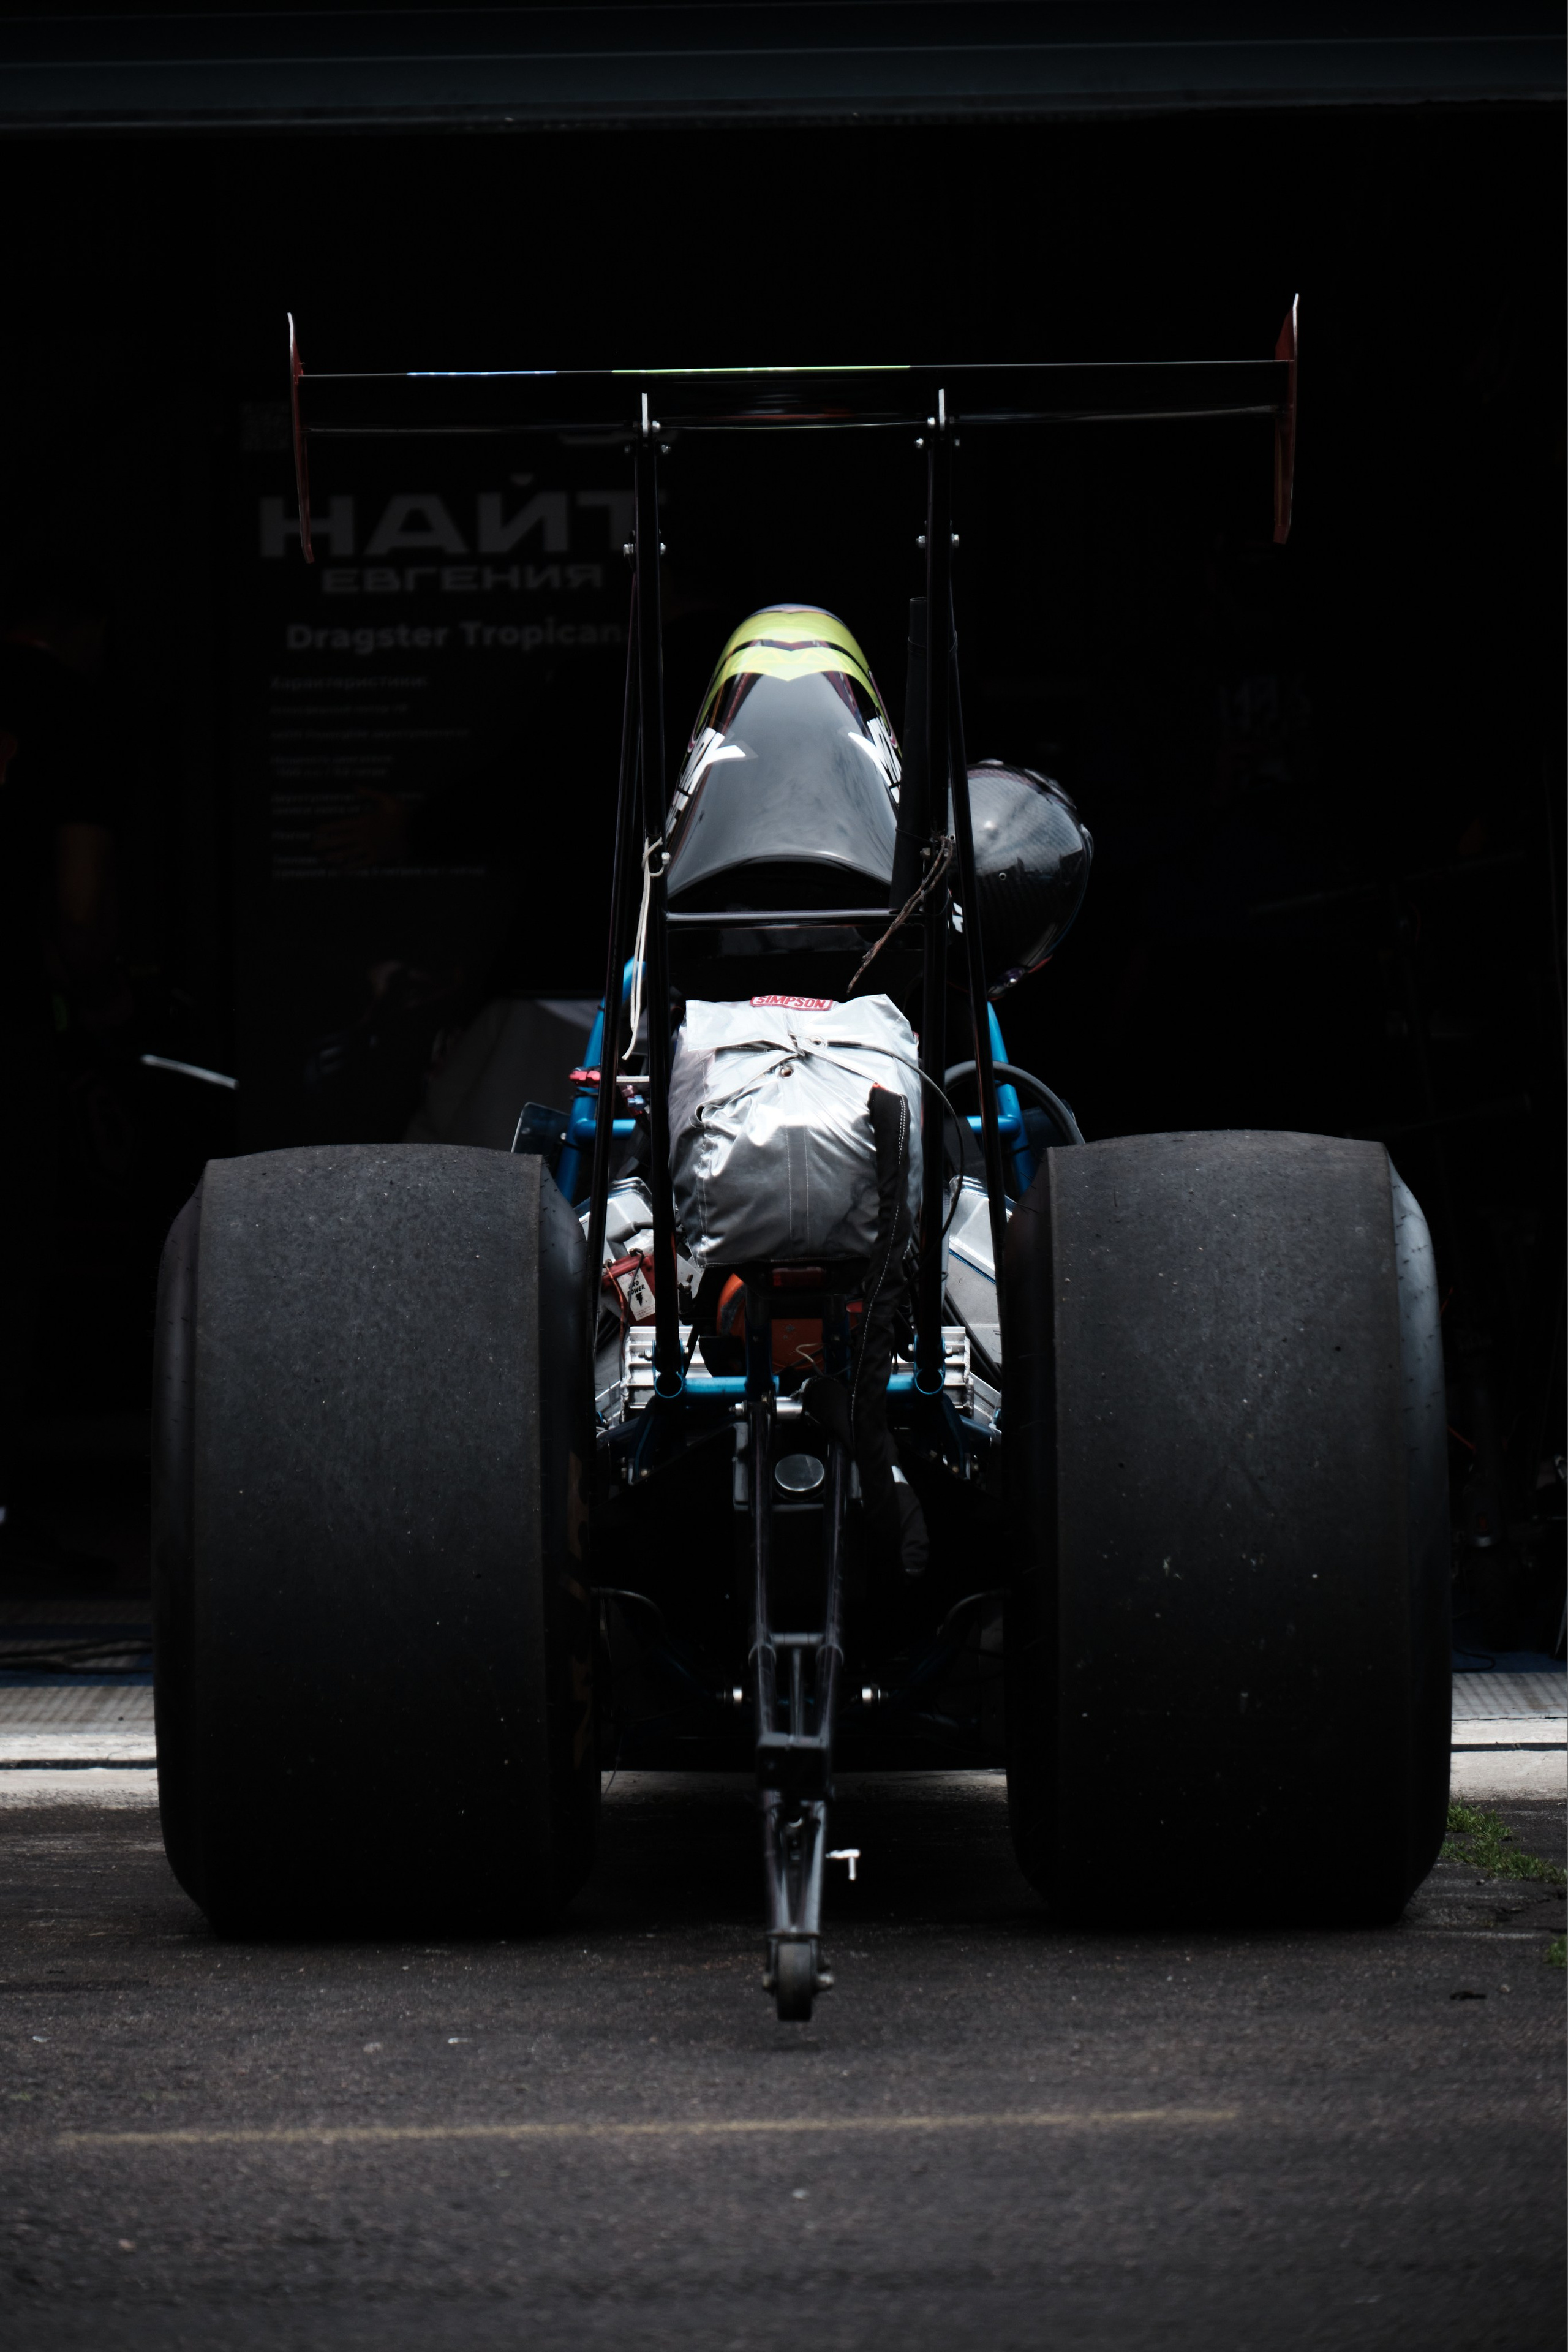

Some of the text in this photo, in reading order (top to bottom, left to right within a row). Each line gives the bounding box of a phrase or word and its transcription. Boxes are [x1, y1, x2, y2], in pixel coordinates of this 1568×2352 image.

[260, 472, 668, 558] НАЙТ
[321, 564, 604, 594] ЕВГЕНИЯ
[286, 616, 630, 654] Dragster Tropican
[756, 995, 826, 1008] SIMPSON
